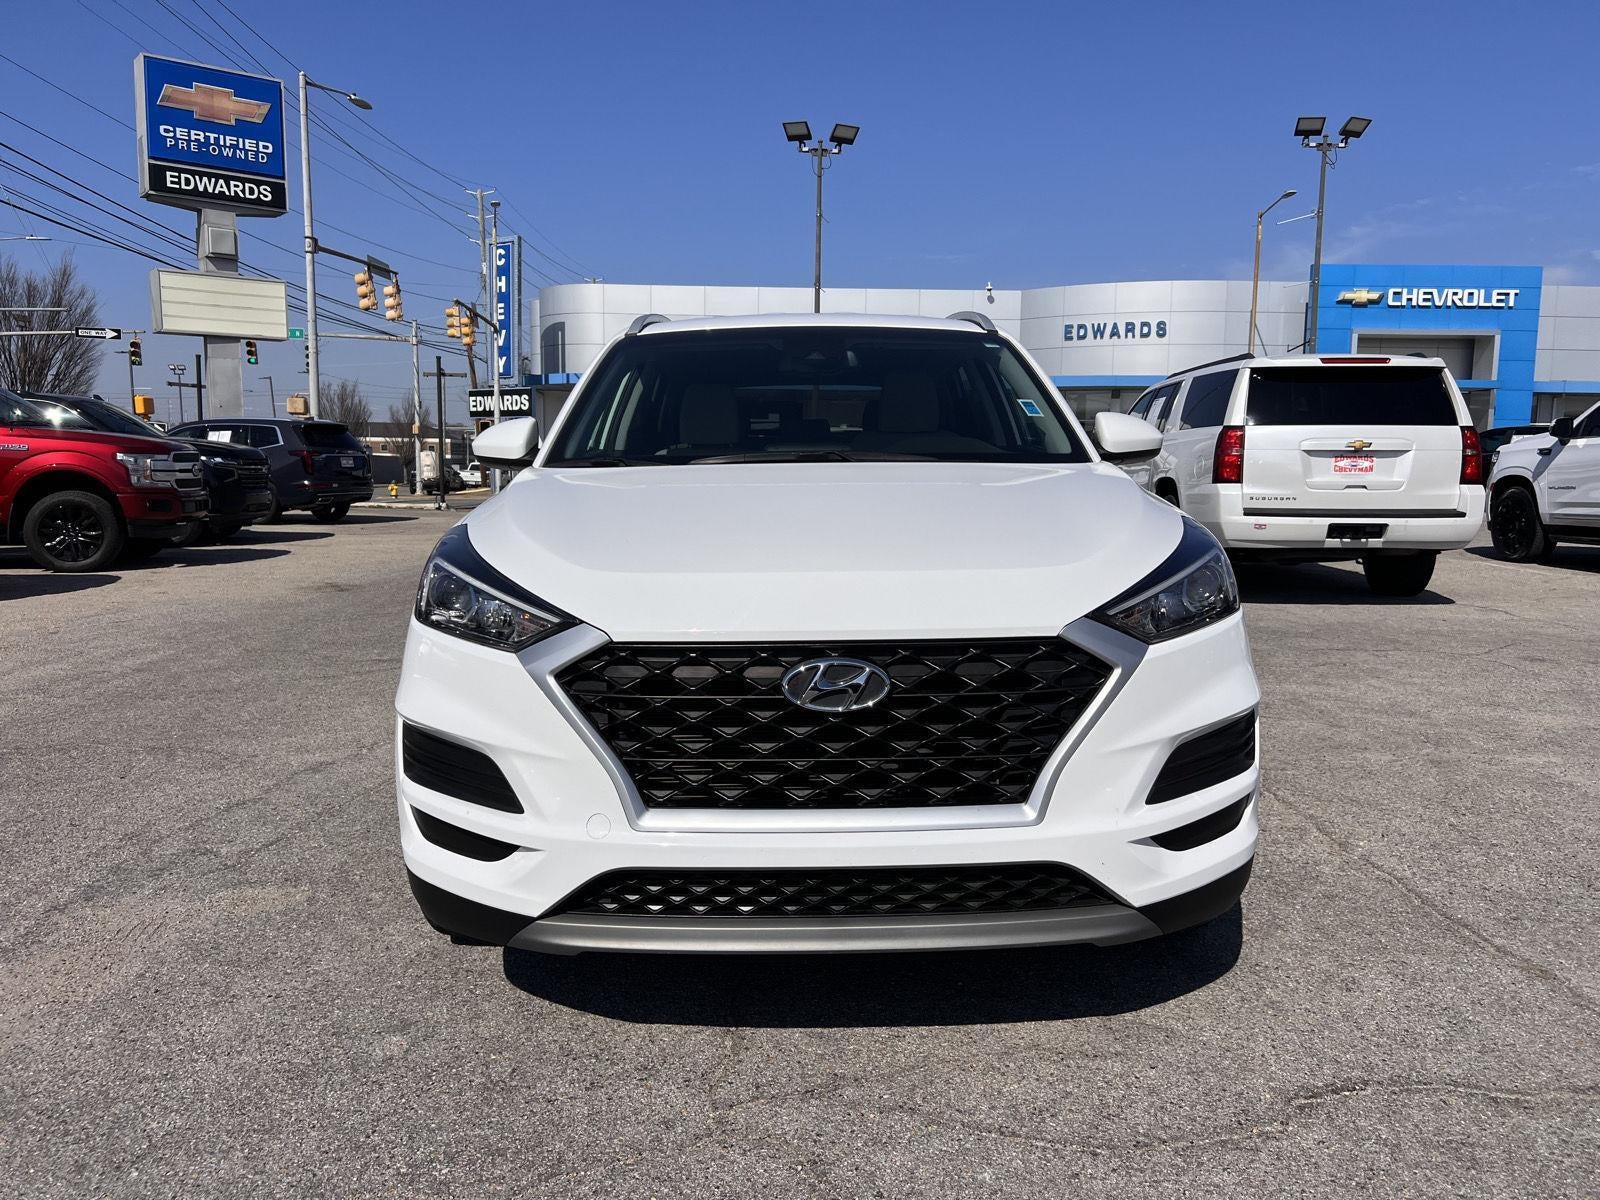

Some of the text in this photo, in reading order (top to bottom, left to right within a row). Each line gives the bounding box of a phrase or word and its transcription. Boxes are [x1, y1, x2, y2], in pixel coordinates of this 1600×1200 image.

[159, 125, 273, 154] CERTIFIED
[166, 137, 267, 163] PRE-OWNED
[166, 171, 272, 201] EDWARDS
[496, 248, 506, 373] CHEVY
[1387, 288, 1520, 308] CHEVROLET
[1064, 320, 1167, 341] EDWARDS
[1333, 464, 1375, 473] CHEVYMAN
